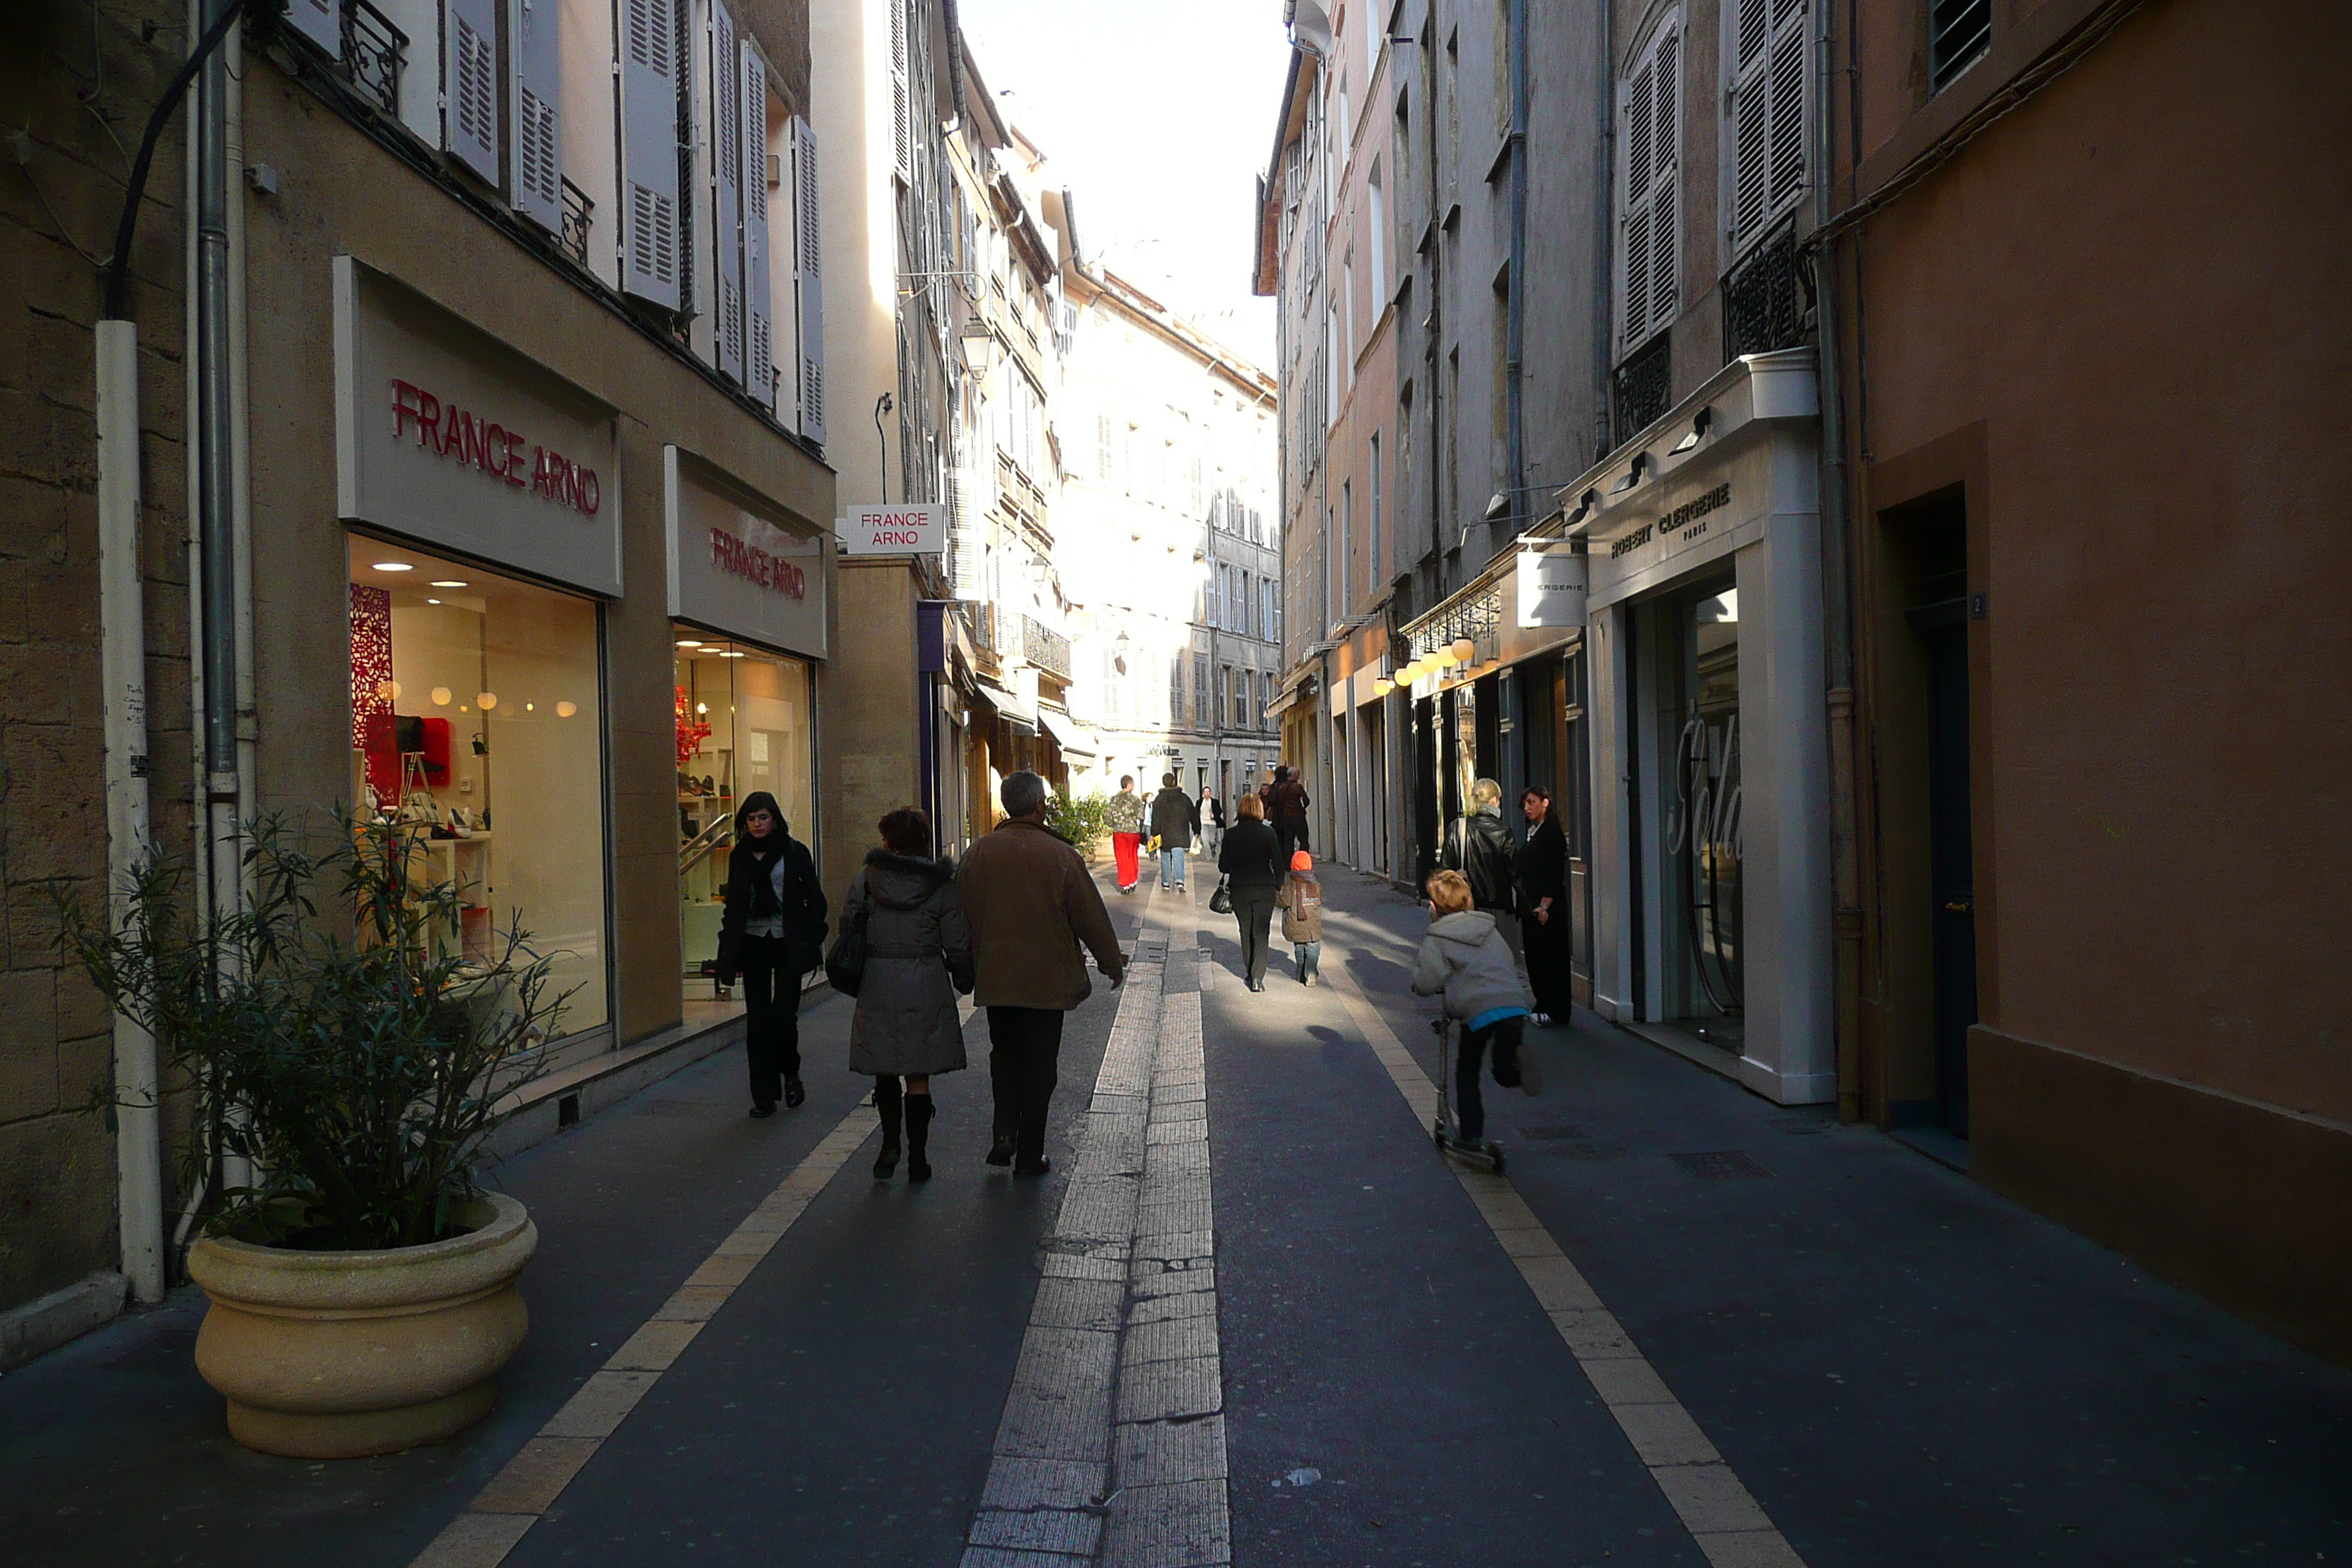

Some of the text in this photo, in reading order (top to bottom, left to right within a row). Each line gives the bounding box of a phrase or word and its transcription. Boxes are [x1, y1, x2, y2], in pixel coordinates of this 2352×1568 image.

[391, 378, 600, 515] FRANCE ARNO
[861, 512, 928, 527] FRANCE
[872, 530, 919, 546] ARNO
[1611, 482, 1730, 560] ROBERT CLERGERIE
[1683, 521, 1707, 541] PARIS
[710, 527, 805, 600] FRANCE ARNO
